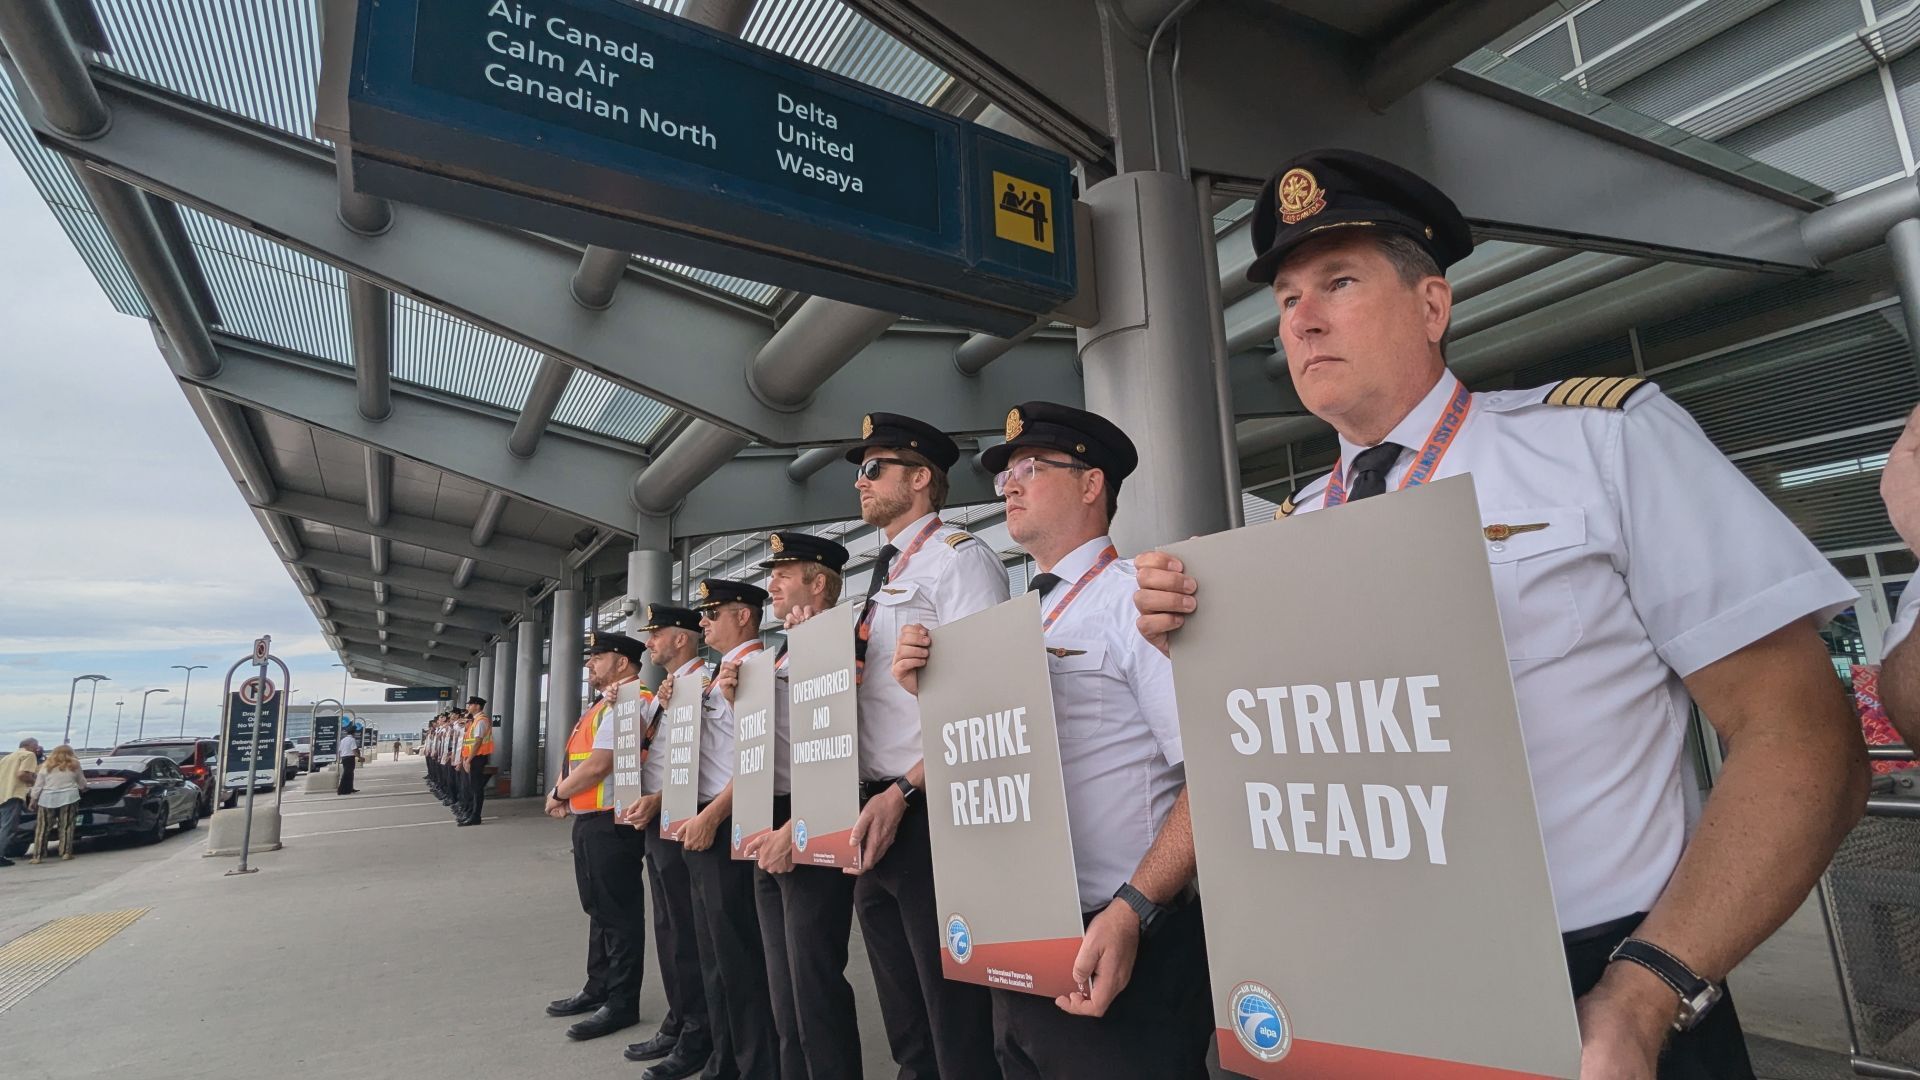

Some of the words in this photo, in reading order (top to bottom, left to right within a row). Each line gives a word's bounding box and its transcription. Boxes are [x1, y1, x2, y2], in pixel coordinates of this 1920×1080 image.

[488, 0, 536, 29] Air
[546, 17, 655, 70] Canada
[487, 31, 565, 72] Calm
[575, 59, 620, 88] Air
[484, 63, 629, 124] Canadian
[639, 108, 717, 150] North
[778, 93, 838, 129] Delta
[778, 121, 854, 162] United
[776, 149, 863, 193] Wasaya
[793, 668, 850, 704] OVERWORKED
[677, 705, 693, 723] STAND
[740, 709, 767, 742] STRIKE
[812, 706, 830, 731] AND
[1226, 675, 1451, 755] STRIKE
[671, 727, 683, 744] WITH
[684, 726, 694, 743] AIR
[793, 734, 853, 765] UNDERVALUED
[943, 706, 1031, 766] STRIKE
[671, 747, 691, 764] CANADA
[740, 744, 765, 775] READY
[671, 768, 689, 785] PILOTS
[950, 773, 1031, 826] READY
[1245, 782, 1448, 865] READY
[1250, 984, 1271, 1000] CANADA
[1260, 1027, 1277, 1039] alpa
